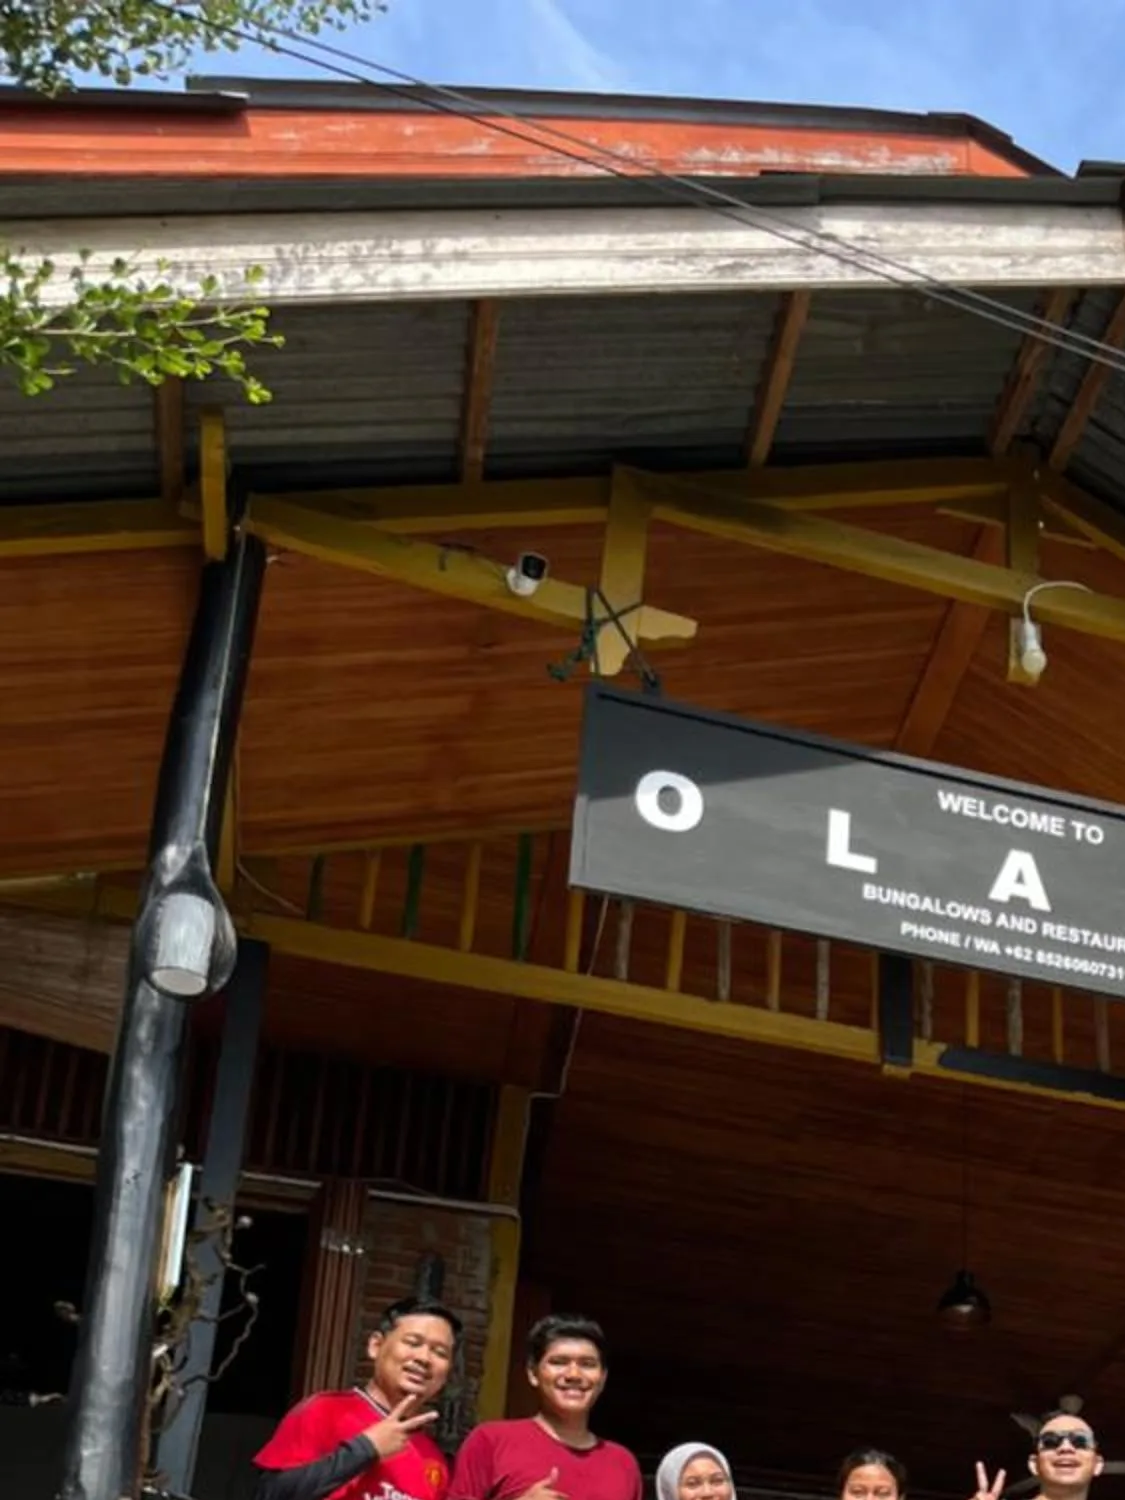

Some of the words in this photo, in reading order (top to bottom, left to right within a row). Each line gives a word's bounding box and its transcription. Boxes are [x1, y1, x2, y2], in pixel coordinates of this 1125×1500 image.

[634, 770, 704, 832] O
[825, 808, 878, 875] L
[987, 848, 1052, 913] A
[937, 789, 1066, 837] WELCOME
[1070, 820, 1105, 845] TO
[862, 883, 993, 926] BUNGALOWS
[995, 911, 1037, 935] AND
[900, 921, 961, 948] PHONE
[963, 935, 972, 949] /
[972, 936, 1001, 955] WA
[1004, 945, 1033, 962] +62
